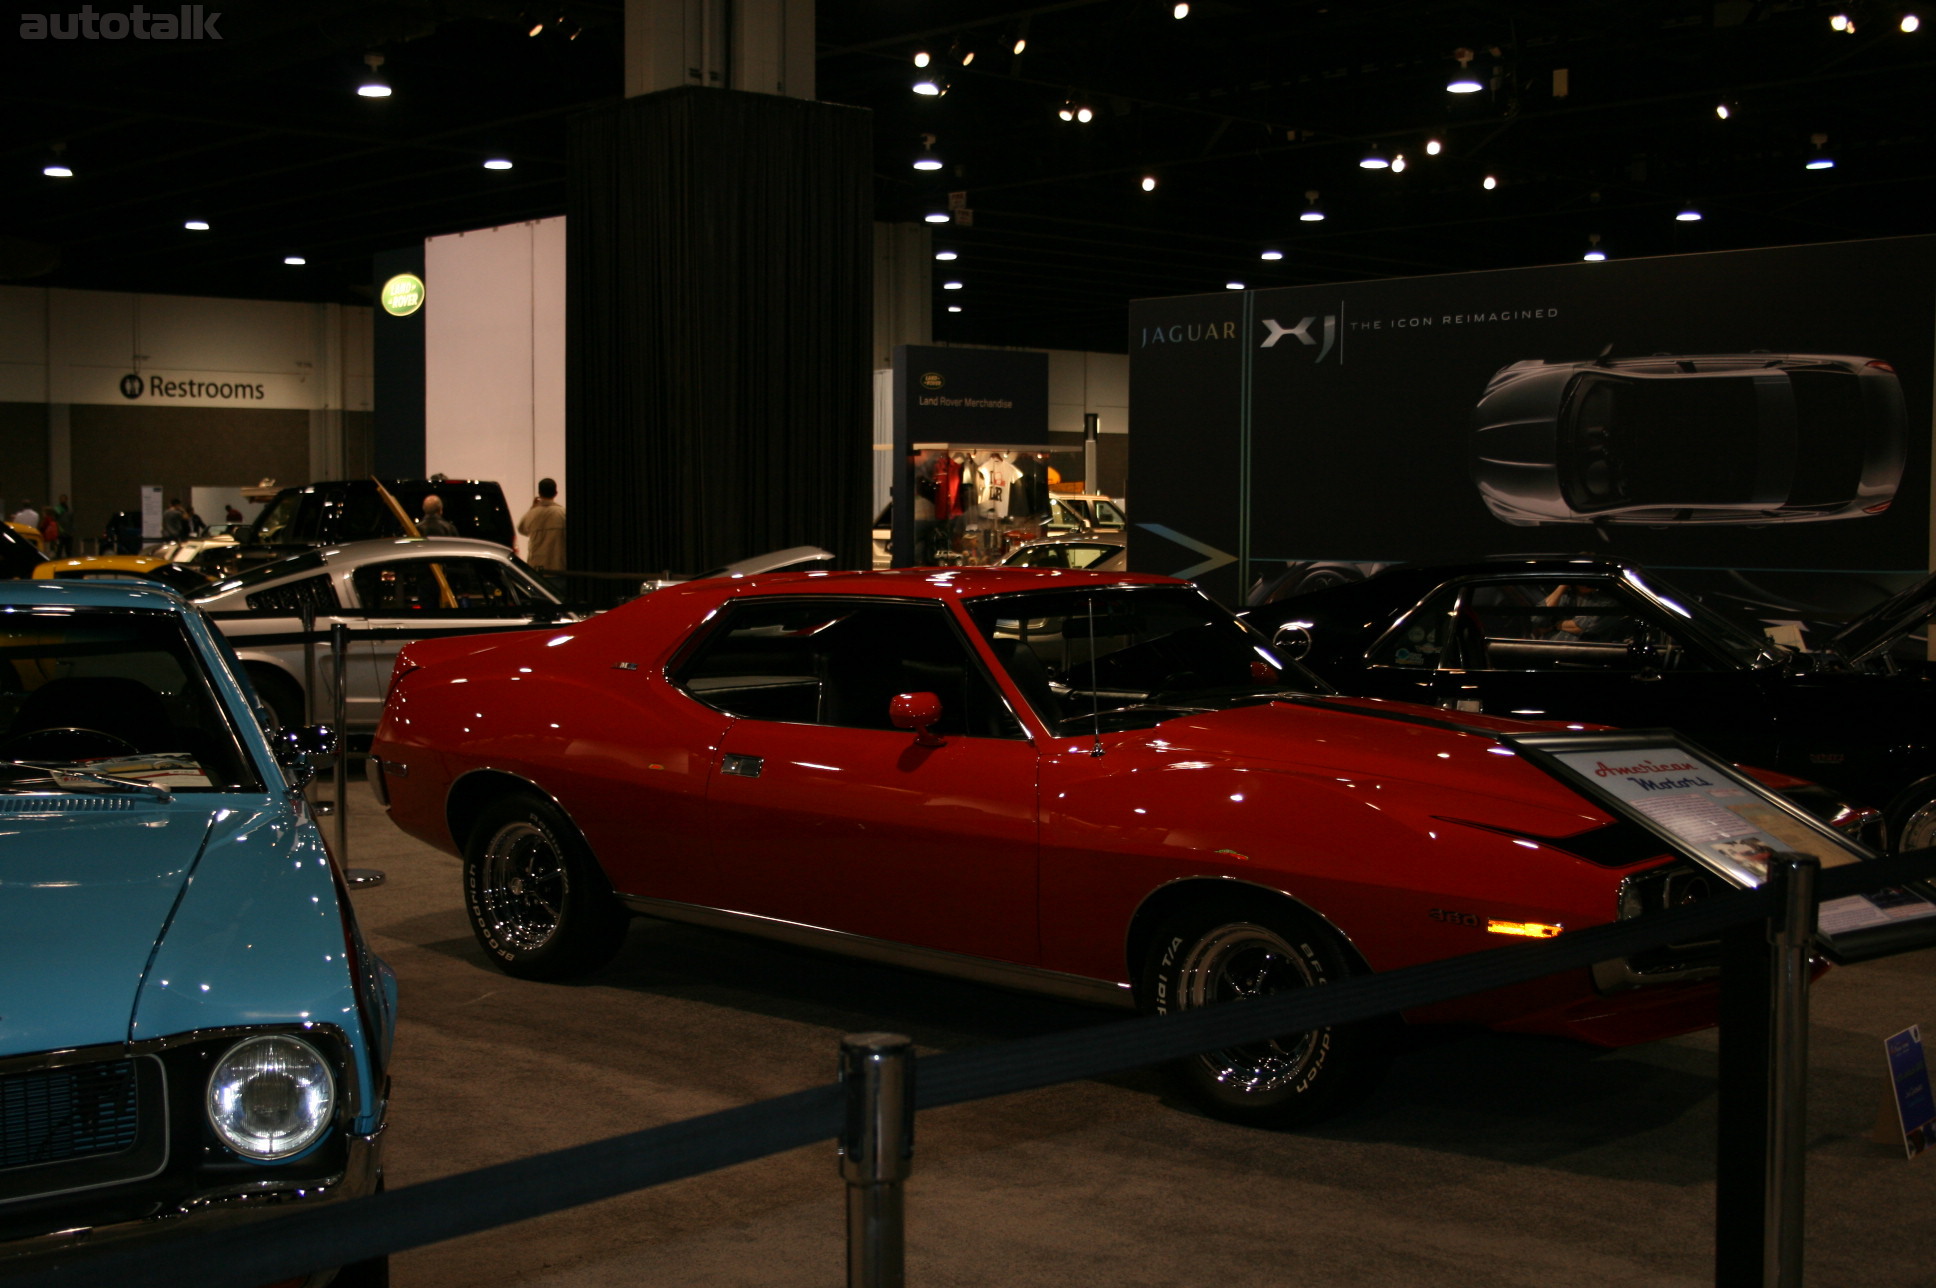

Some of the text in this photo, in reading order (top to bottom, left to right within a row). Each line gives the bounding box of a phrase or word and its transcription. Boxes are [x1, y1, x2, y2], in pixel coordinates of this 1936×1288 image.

[1350, 307, 1559, 332] THE ICON REIMAGINED
[1140, 321, 1237, 349] JAGUAR
[1259, 314, 1336, 365] XJ
[150, 375, 265, 400] Restrooms
[919, 396, 1013, 409] Land Rover Merchandise
[1595, 759, 1699, 778] American
[1626, 776, 1714, 792] Motors
[469, 863, 516, 962] BFGoodrich
[1161, 936, 1184, 967] T/A
